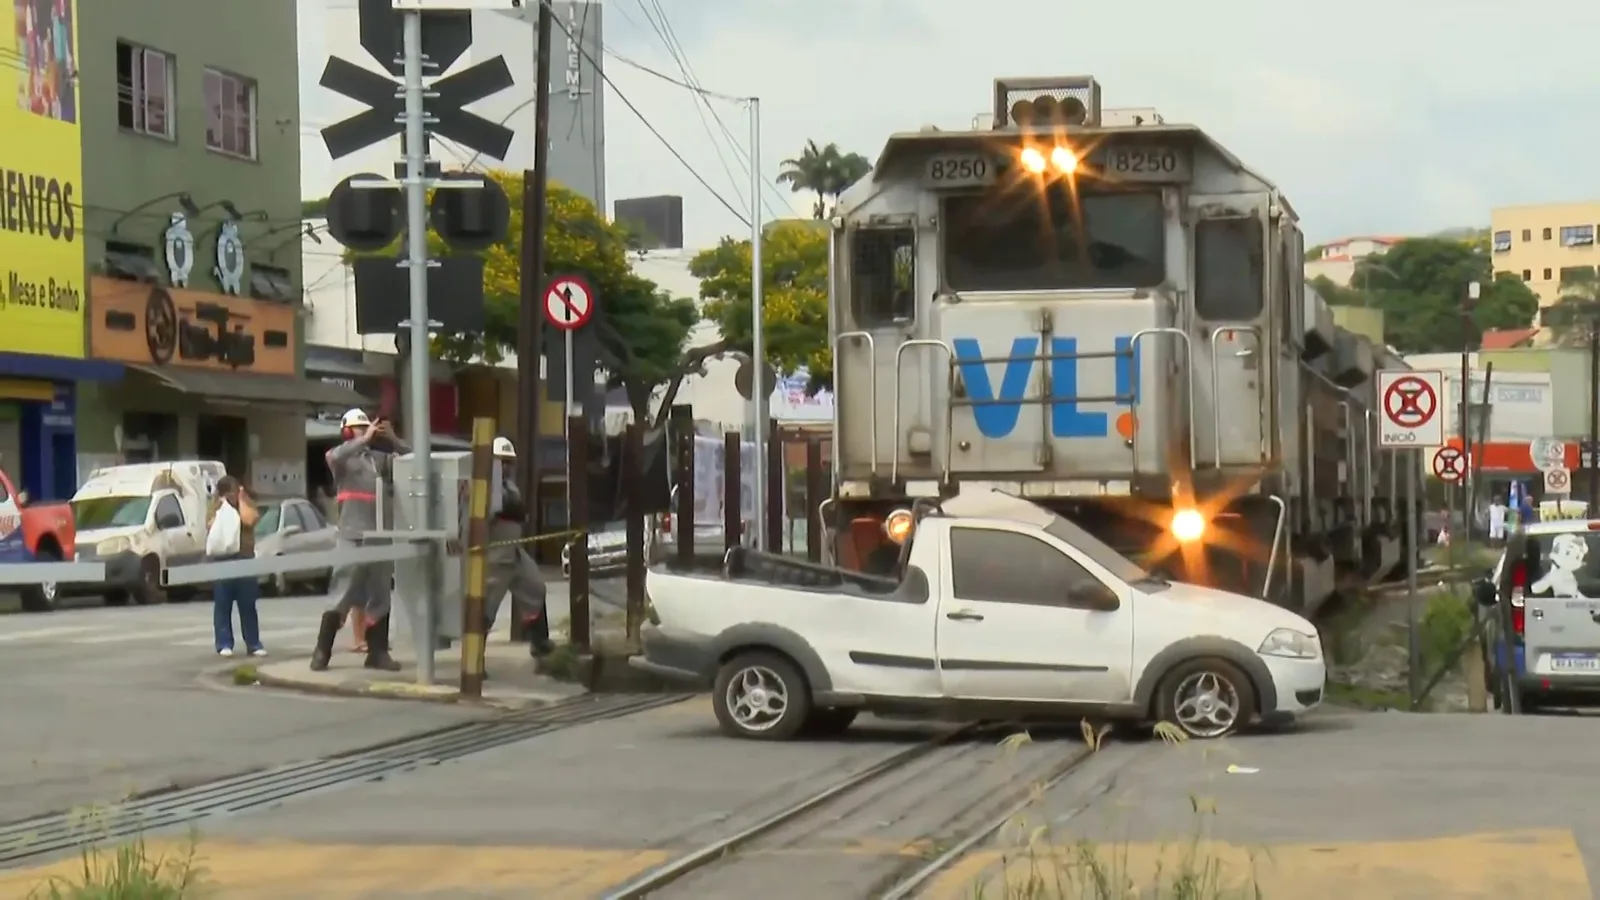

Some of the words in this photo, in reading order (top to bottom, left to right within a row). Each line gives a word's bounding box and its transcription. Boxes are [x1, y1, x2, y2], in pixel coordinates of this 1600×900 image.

[930, 159, 986, 180] 8250
[1115, 152, 1177, 173] 8250
[9, 270, 36, 306] Mesa
[39, 284, 46, 308] e
[49, 276, 79, 312] Banho
